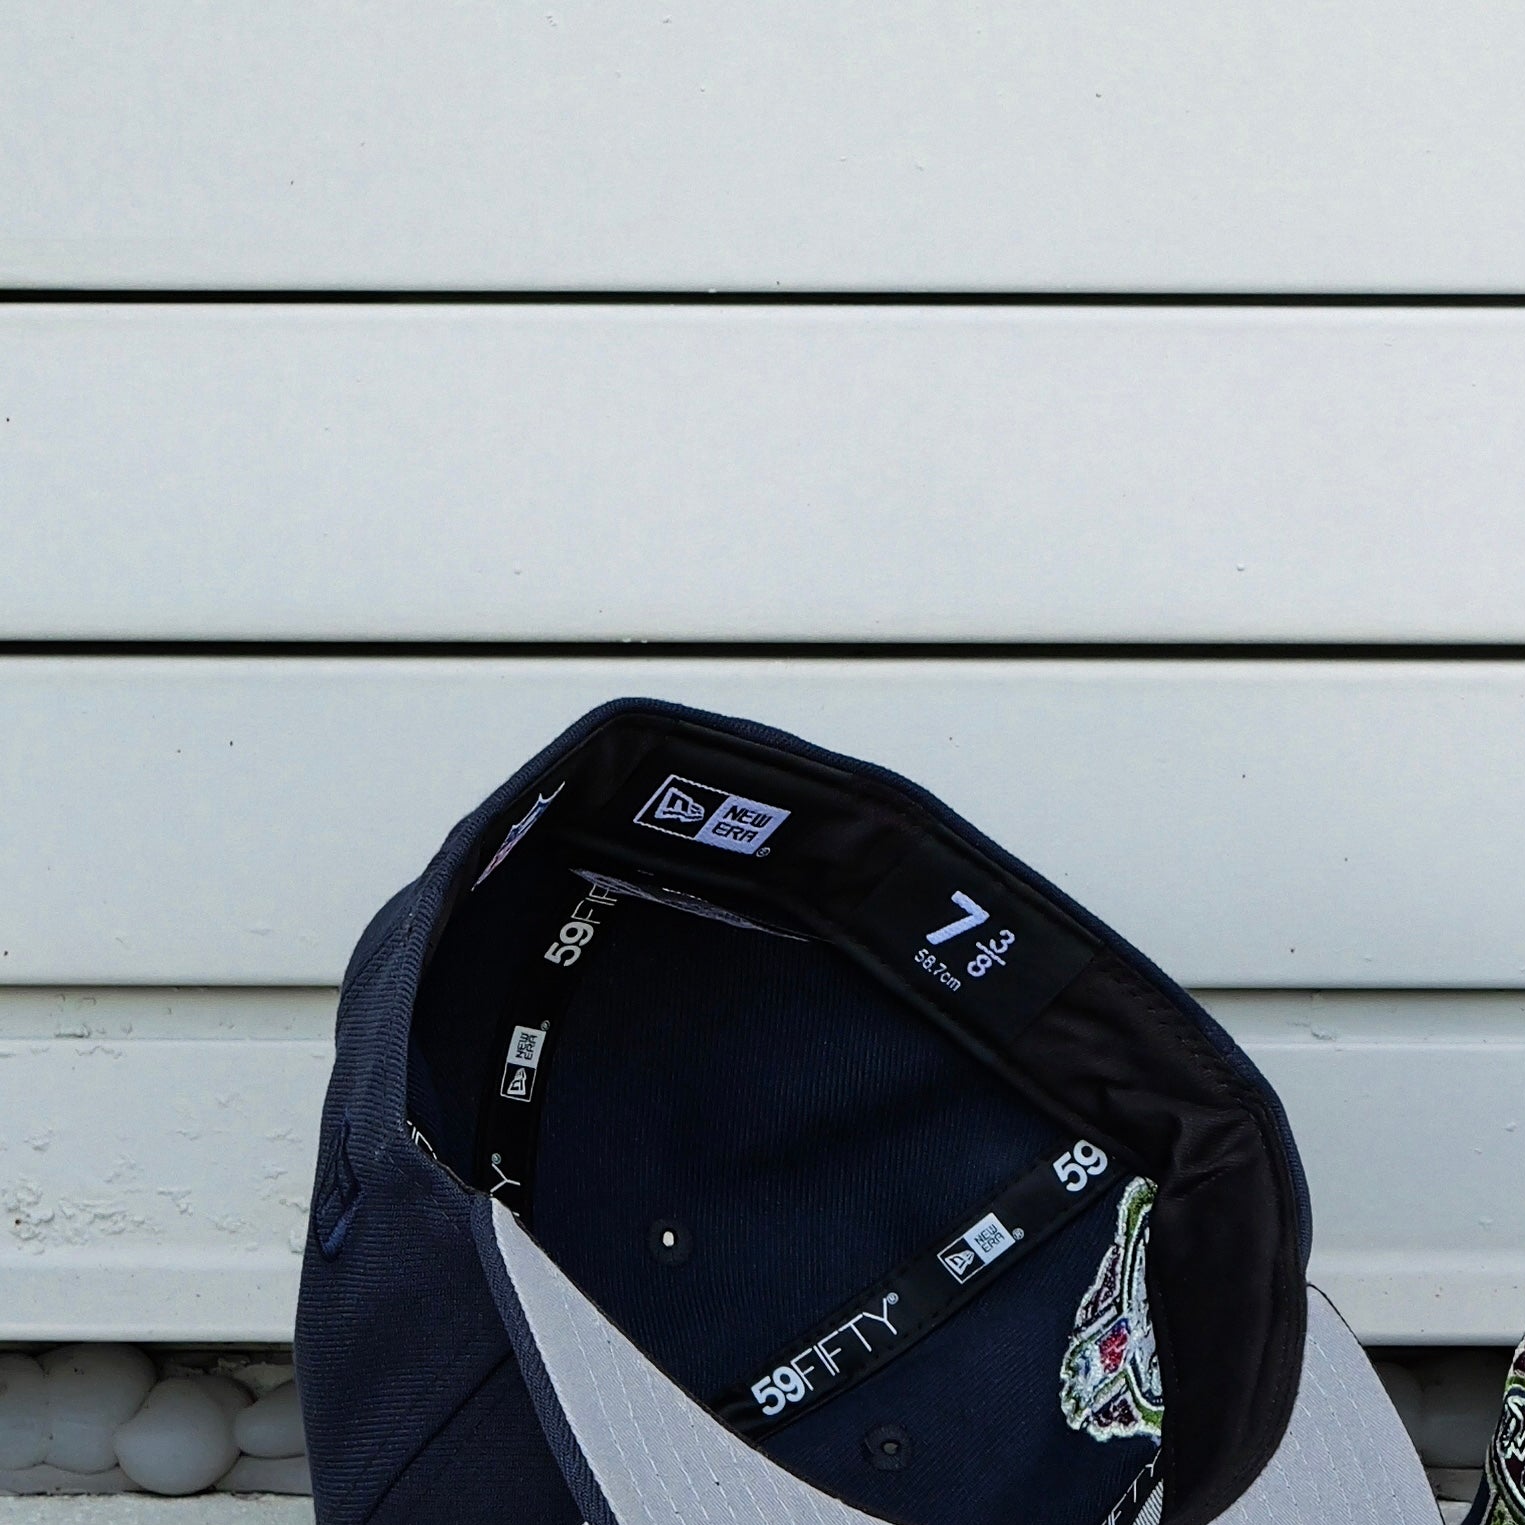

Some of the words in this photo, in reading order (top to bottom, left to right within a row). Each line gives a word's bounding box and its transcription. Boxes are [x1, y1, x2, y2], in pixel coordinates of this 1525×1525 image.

[722, 805, 773, 829] NEW
[711, 821, 759, 843] ERA
[925, 890, 990, 945] 7
[914, 948, 961, 992] 58.7cm
[514, 1031, 530, 1059] NEW
[973, 1223, 998, 1247] NEW
[980, 1232, 1005, 1253] ERA
[750, 1297, 898, 1416] 59FIFTY
